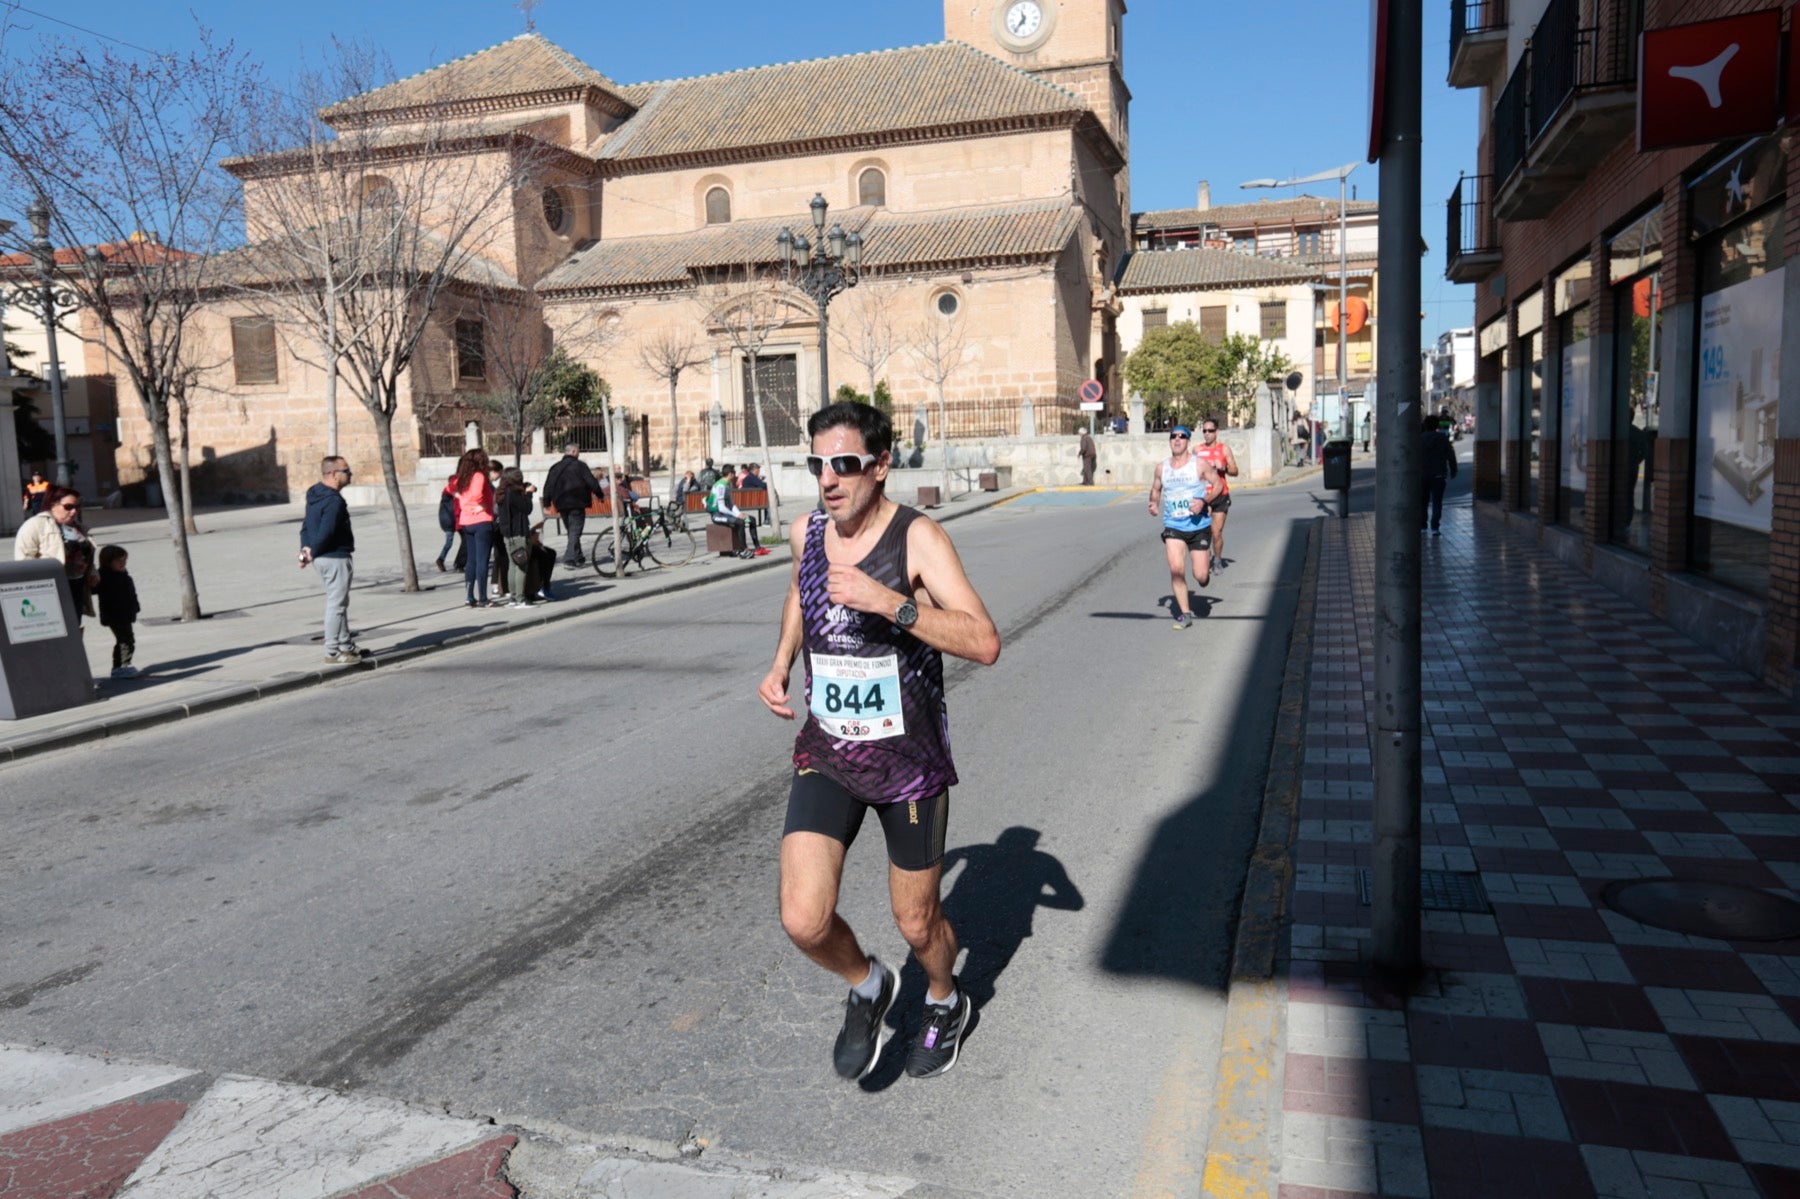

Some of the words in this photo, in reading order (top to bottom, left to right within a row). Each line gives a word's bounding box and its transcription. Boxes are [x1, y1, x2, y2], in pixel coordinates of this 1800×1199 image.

[1703, 345, 1723, 380] 149
[1172, 499, 1189, 510] 140
[825, 683, 885, 714] 844
